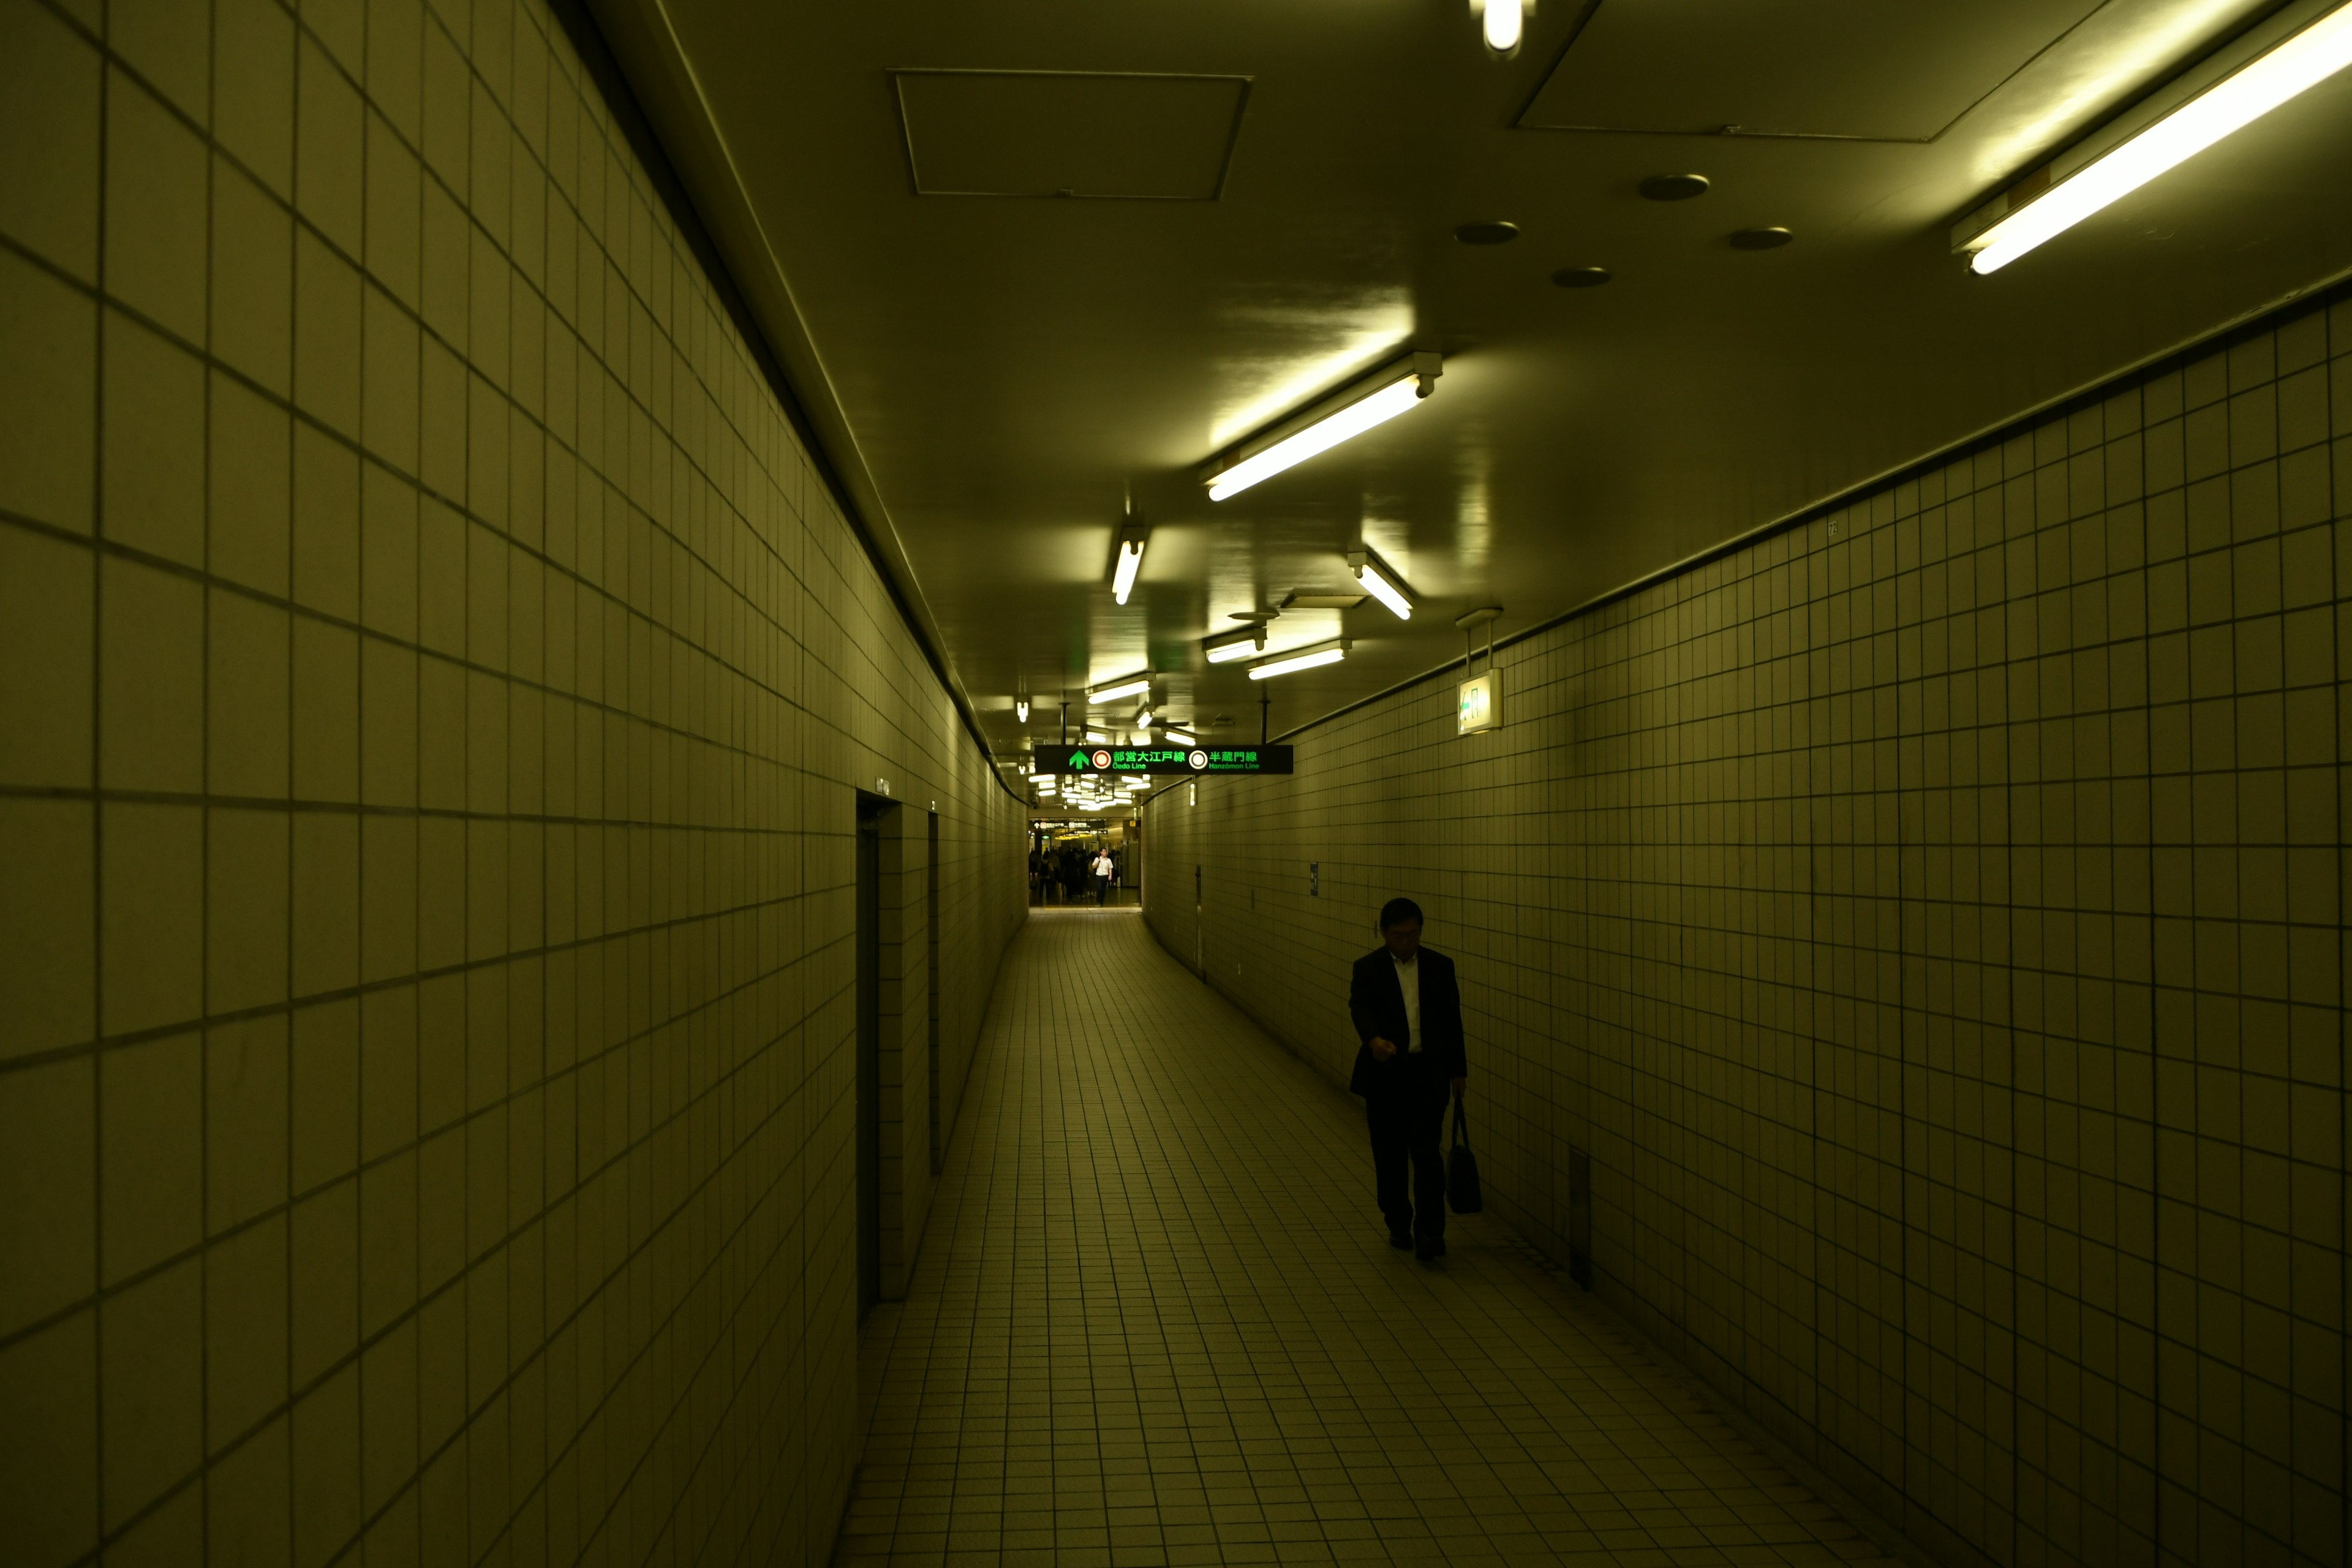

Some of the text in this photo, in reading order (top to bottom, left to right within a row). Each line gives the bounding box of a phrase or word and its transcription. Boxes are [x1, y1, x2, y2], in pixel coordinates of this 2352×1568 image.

[1113, 751, 1185, 762] 都営大江戸線
[1209, 751, 1257, 762] 半蔵門線
